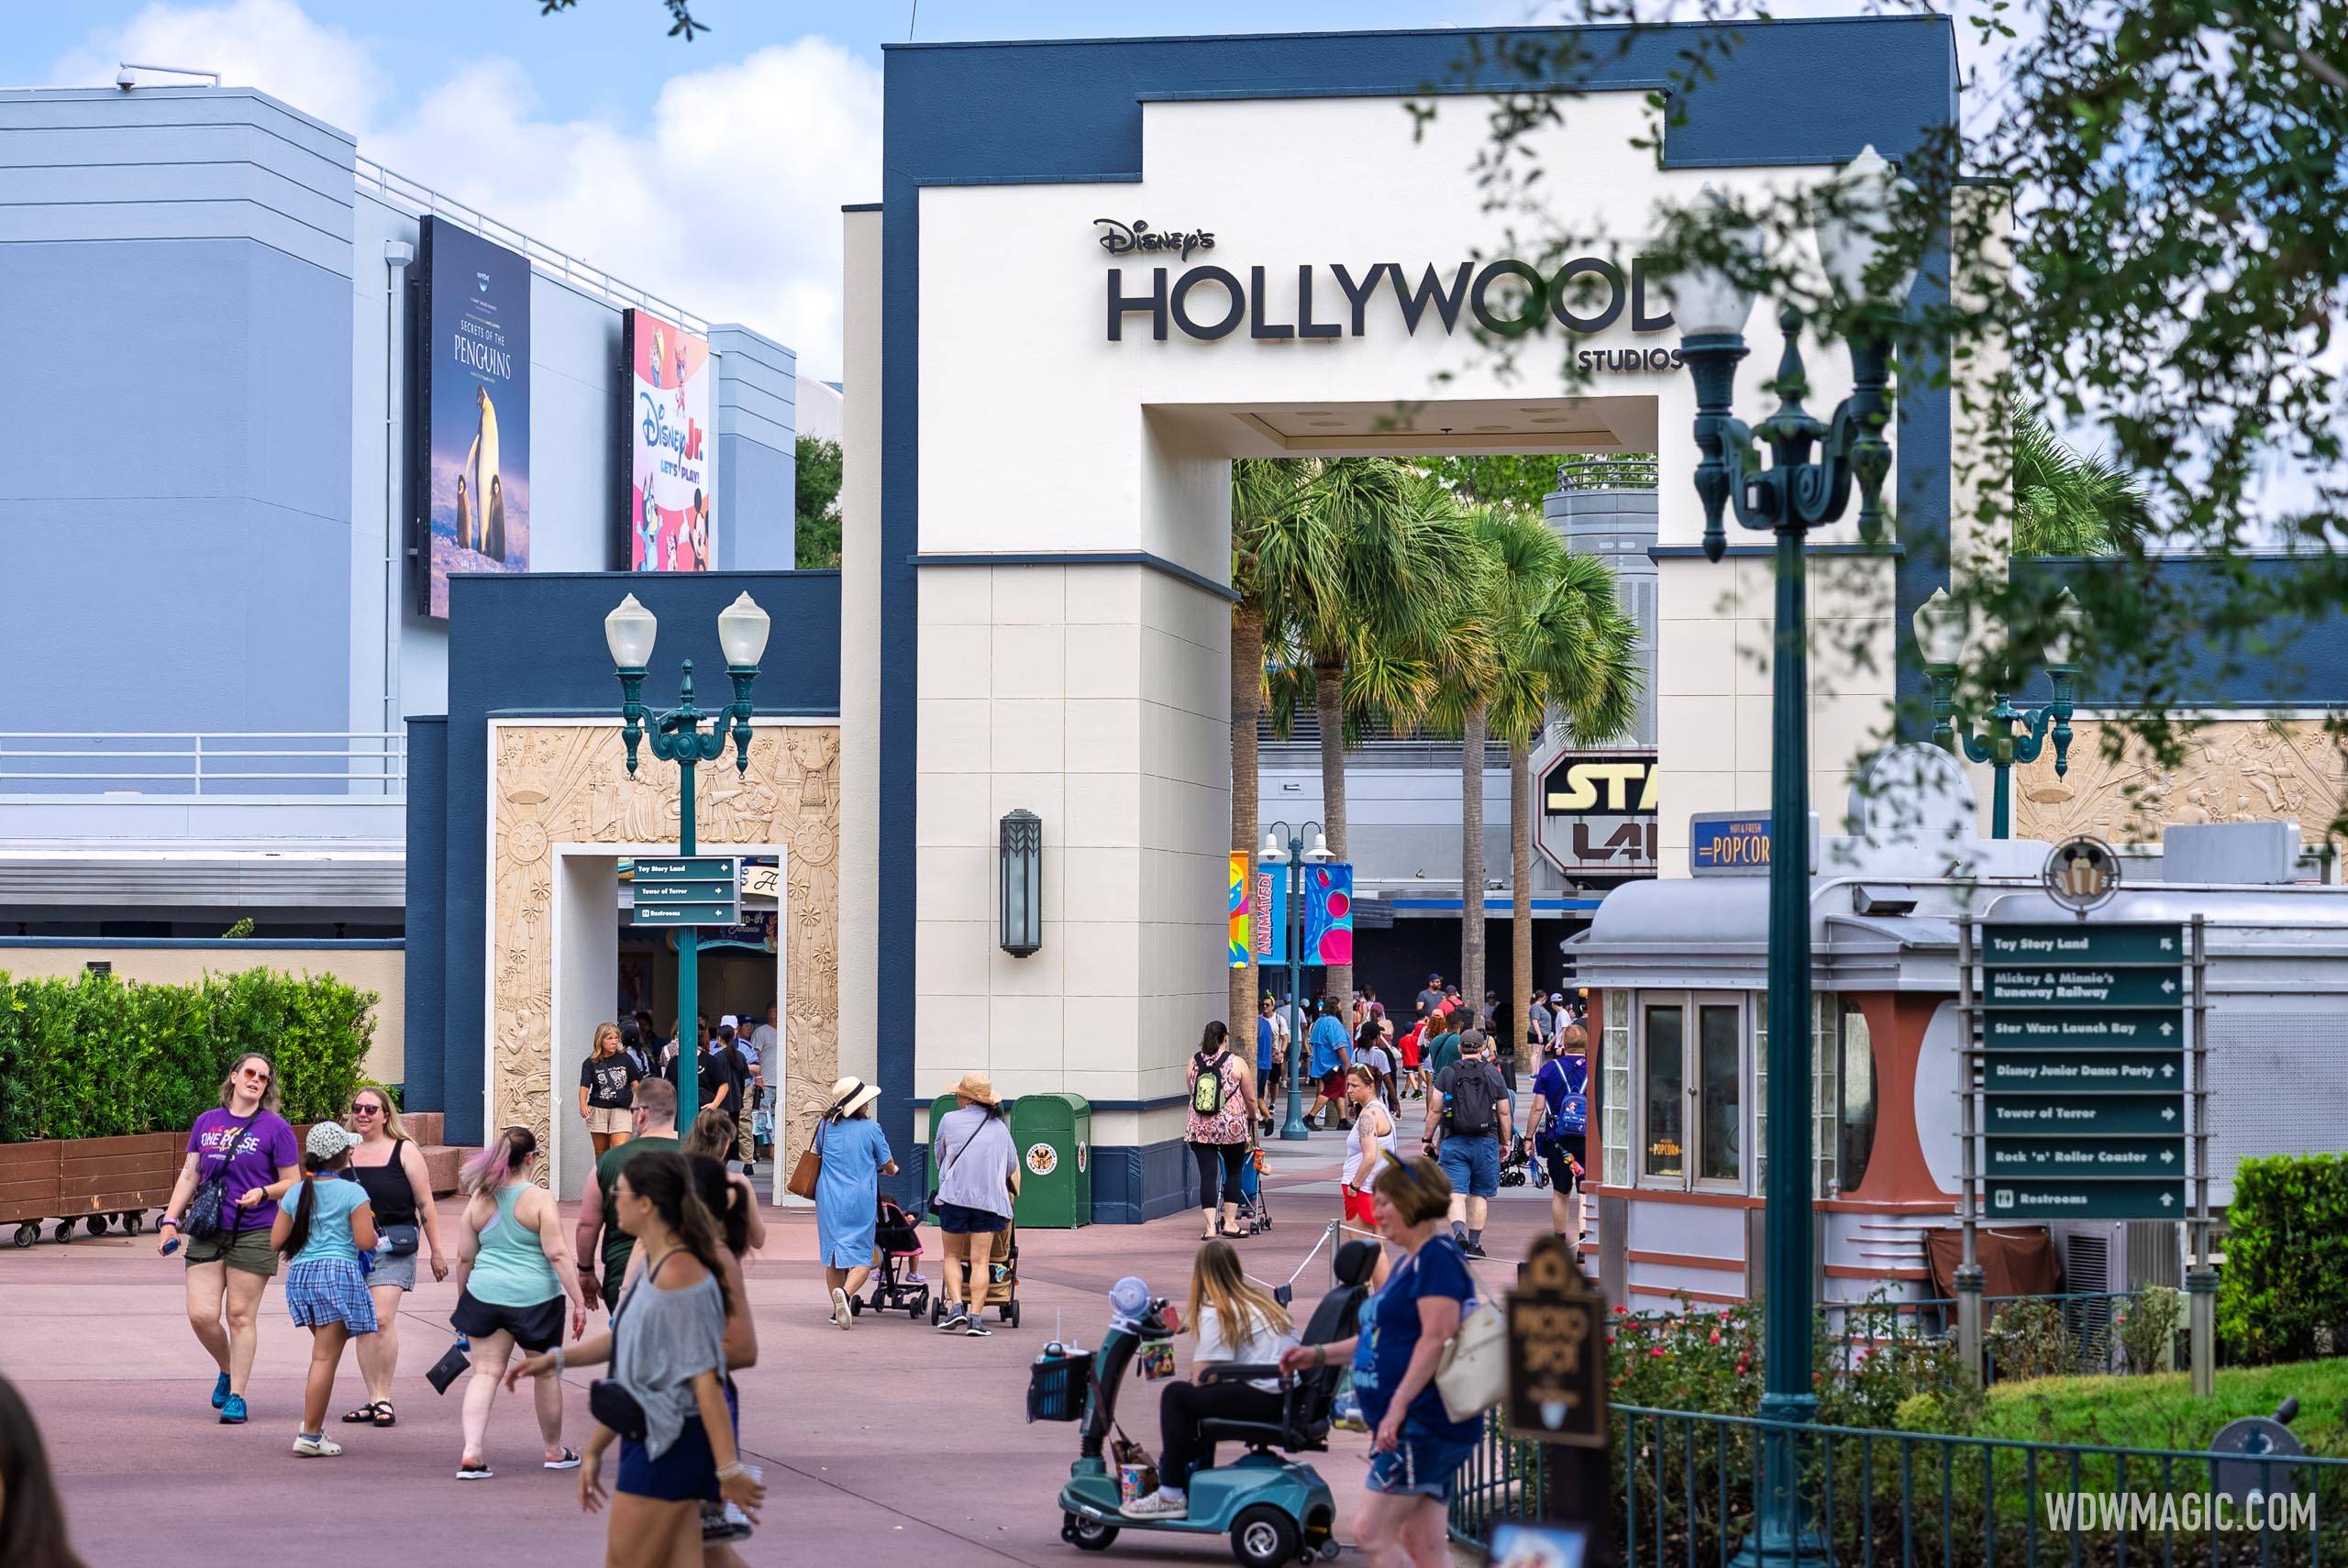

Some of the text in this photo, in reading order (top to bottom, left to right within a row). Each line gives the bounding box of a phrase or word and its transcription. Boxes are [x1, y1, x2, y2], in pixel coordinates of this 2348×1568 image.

[1093, 218, 1215, 262] Disney's
[460, 319, 484, 338] SECRETS
[485, 329, 493, 341] OF
[494, 333, 505, 347] THE
[454, 334, 511, 380] PENGUINS
[1578, 348, 1684, 371] STUDIOS
[639, 392, 703, 471] Disney Jr.
[660, 459, 700, 485] LET'S PLAY!
[1713, 835, 1770, 863] POPCOR
[1257, 873, 1274, 956] ANIMATED!
[1993, 937, 2089, 952] Toy Story Land
[1994, 972, 2115, 986] Mickey & Minnie's
[1994, 986, 2109, 1000] Runaway Railway
[1995, 1022, 2137, 1036] Star Wars Launch Bay
[1996, 1064, 2154, 1078] Disney Junior Dance Party
[1996, 1107, 2097, 1119] Tower of Terror
[201, 1132, 221, 1146] ONE
[1653, 1143, 1679, 1155] POPCORN
[1995, 1151, 2027, 1162] Rock
[2054, 1151, 2095, 1162] Roller
[2098, 1152, 2148, 1162] Coaster
[2020, 1194, 2088, 1204] Restrooms
